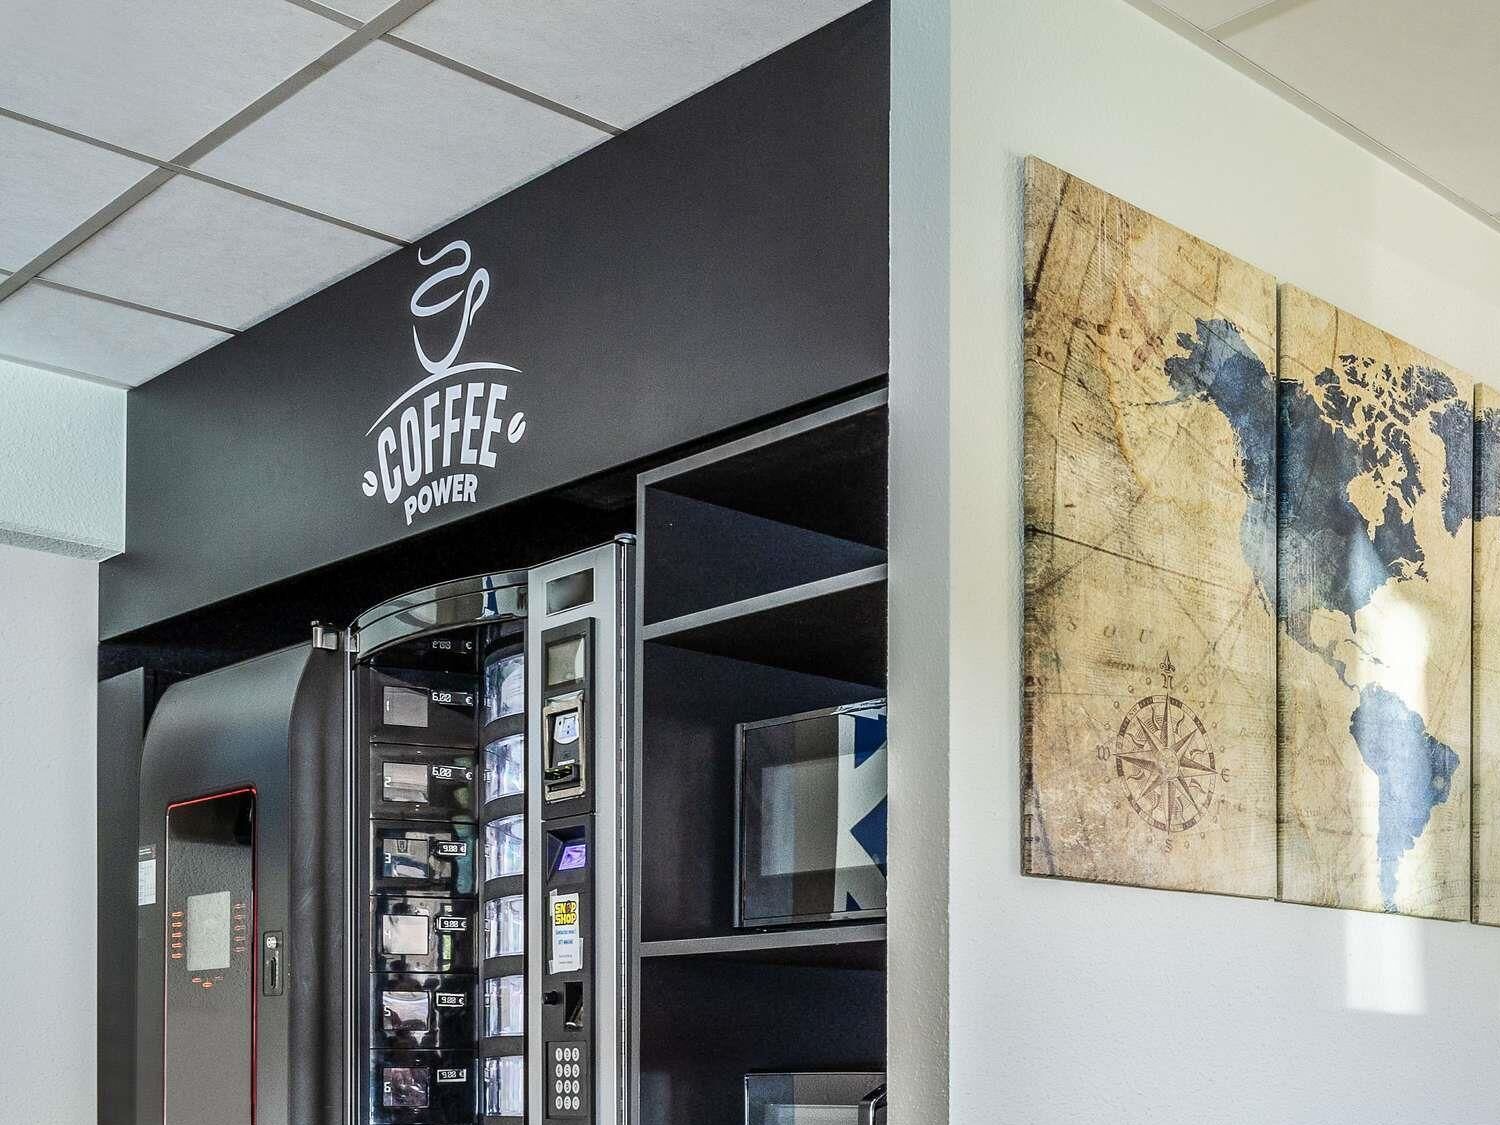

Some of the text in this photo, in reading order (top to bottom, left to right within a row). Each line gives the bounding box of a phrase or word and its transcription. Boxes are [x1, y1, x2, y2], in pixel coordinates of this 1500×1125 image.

[378, 382, 508, 504] COFFEE
[404, 474, 478, 526] POWER
[555, 912, 577, 926] SHOP
